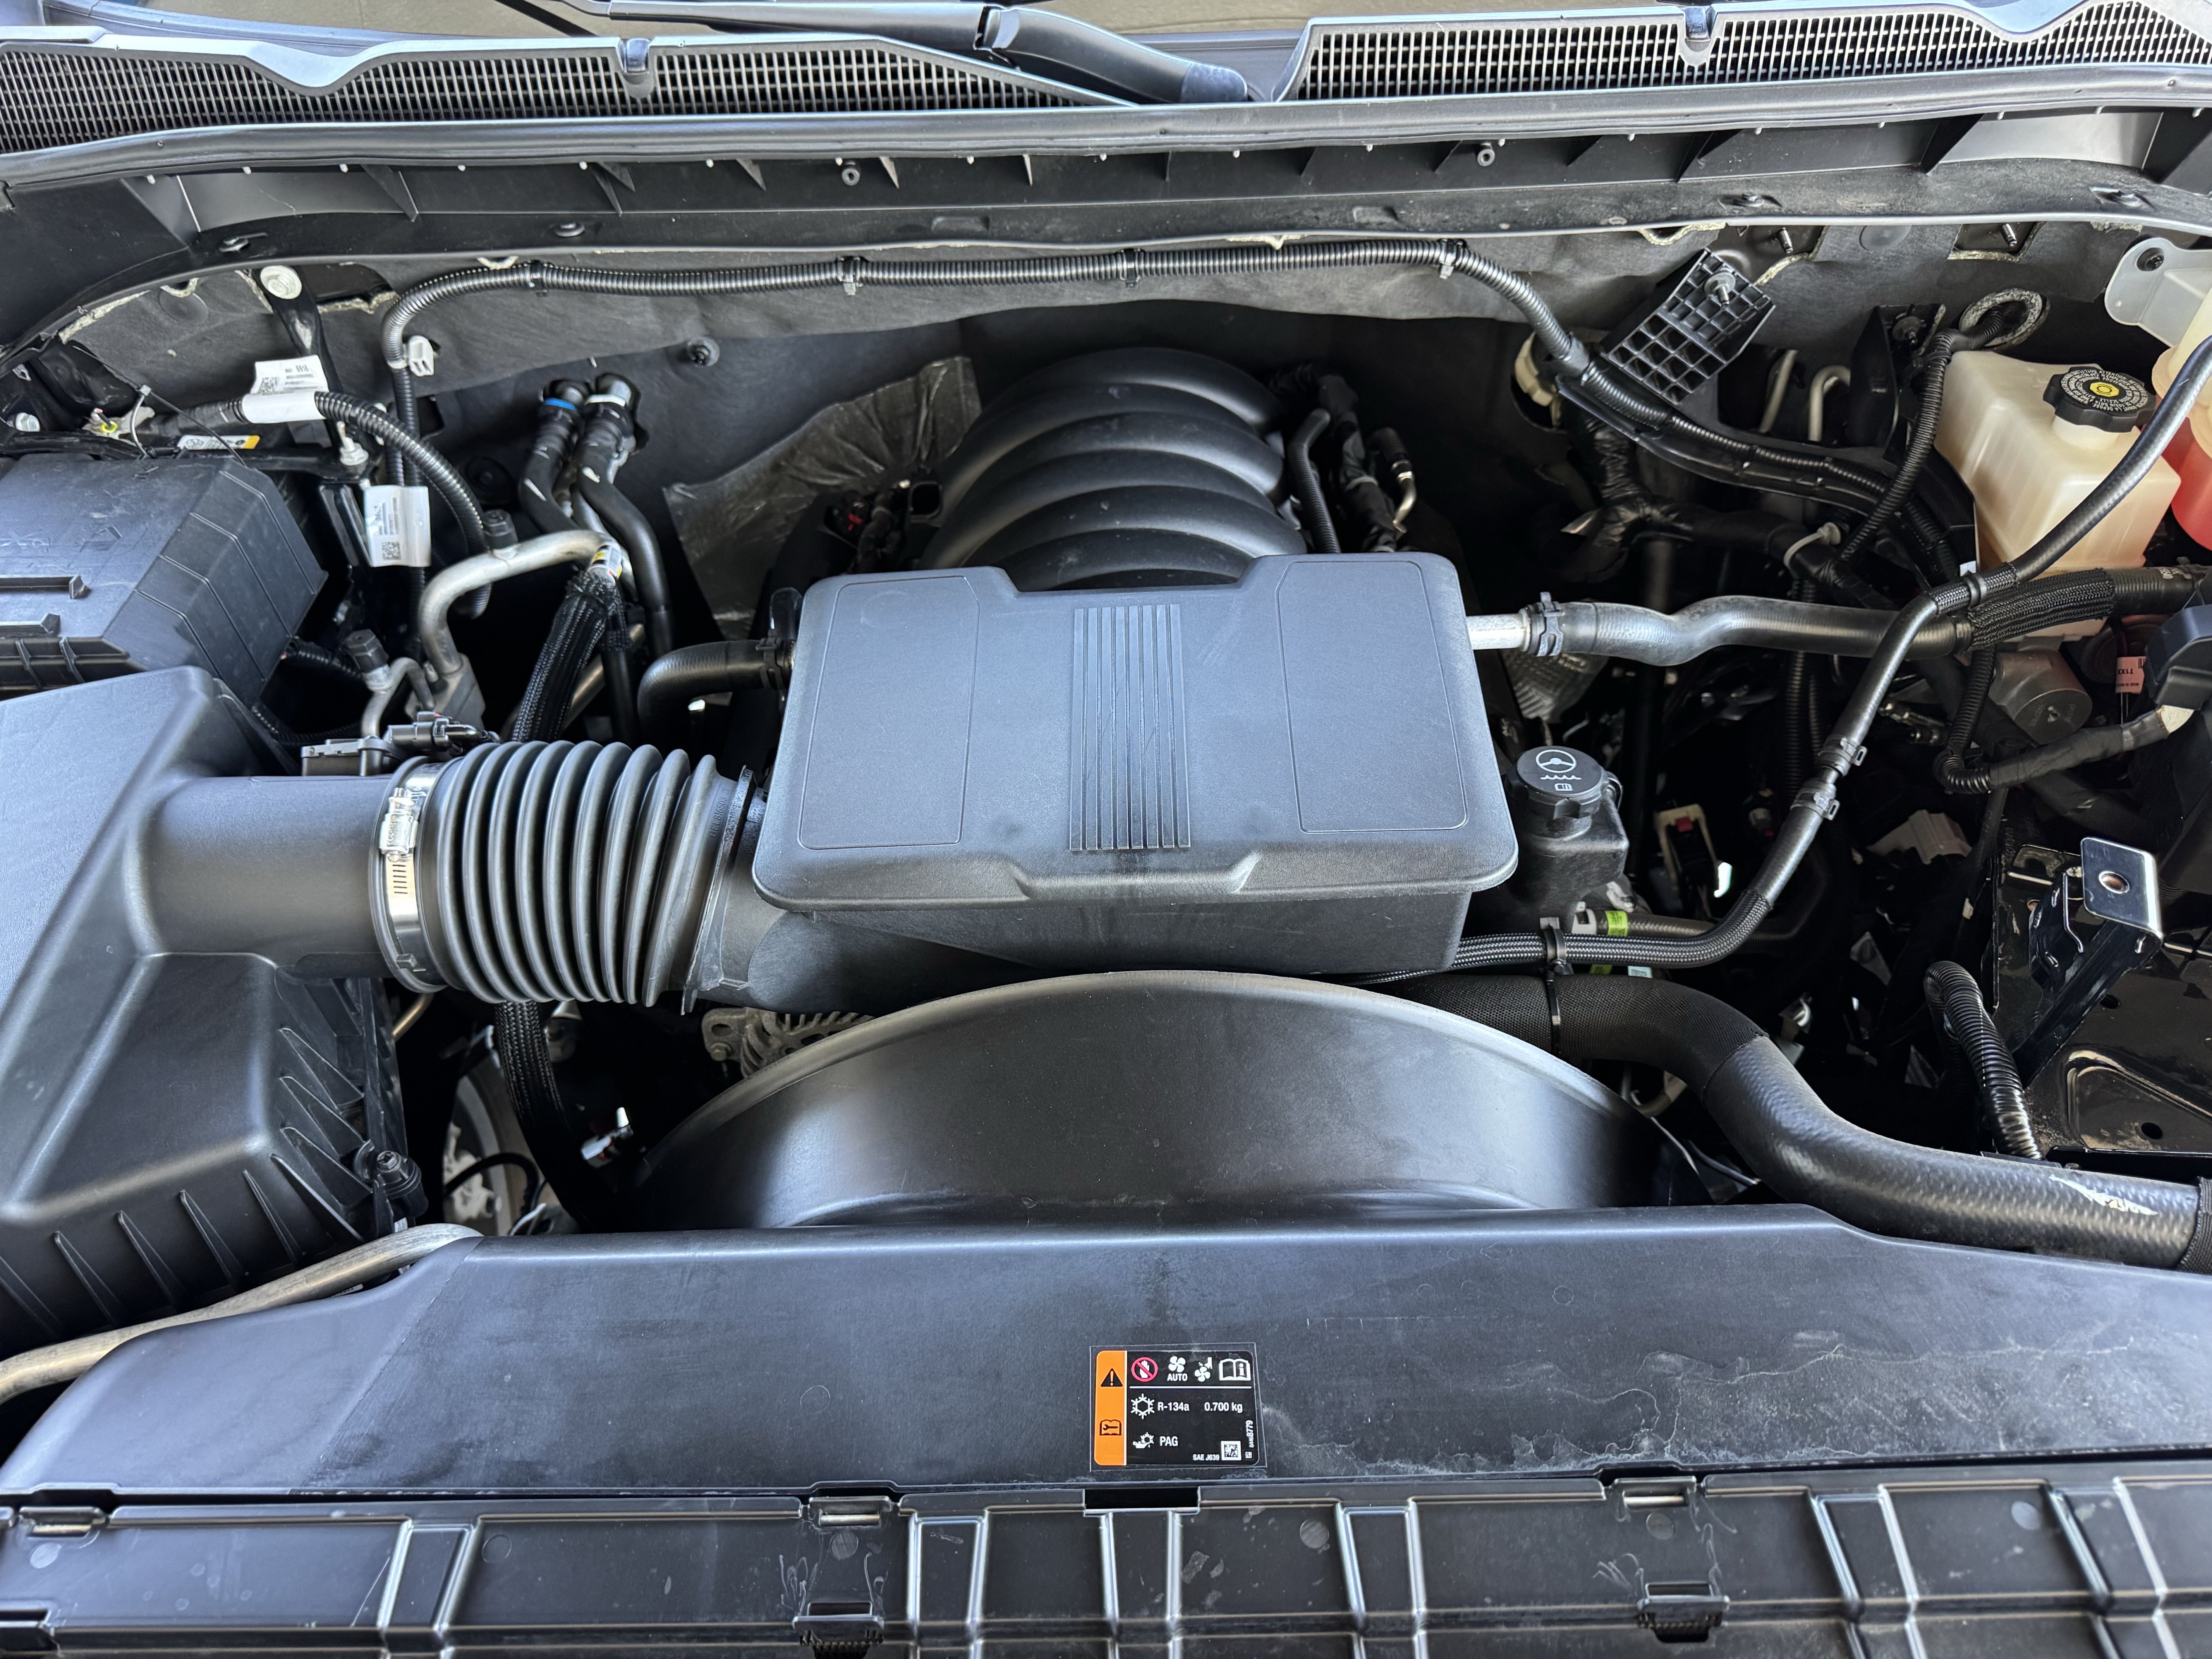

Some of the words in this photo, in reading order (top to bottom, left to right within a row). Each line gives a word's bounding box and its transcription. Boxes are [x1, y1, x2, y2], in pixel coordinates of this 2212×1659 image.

[1167, 1373, 1188, 1381] AUTO
[1158, 1402, 1190, 1411] R-134a
[1204, 1402, 1229, 1411] 0.700
[1231, 1402, 1243, 1413] kg
[1160, 1436, 1178, 1446] PAG
